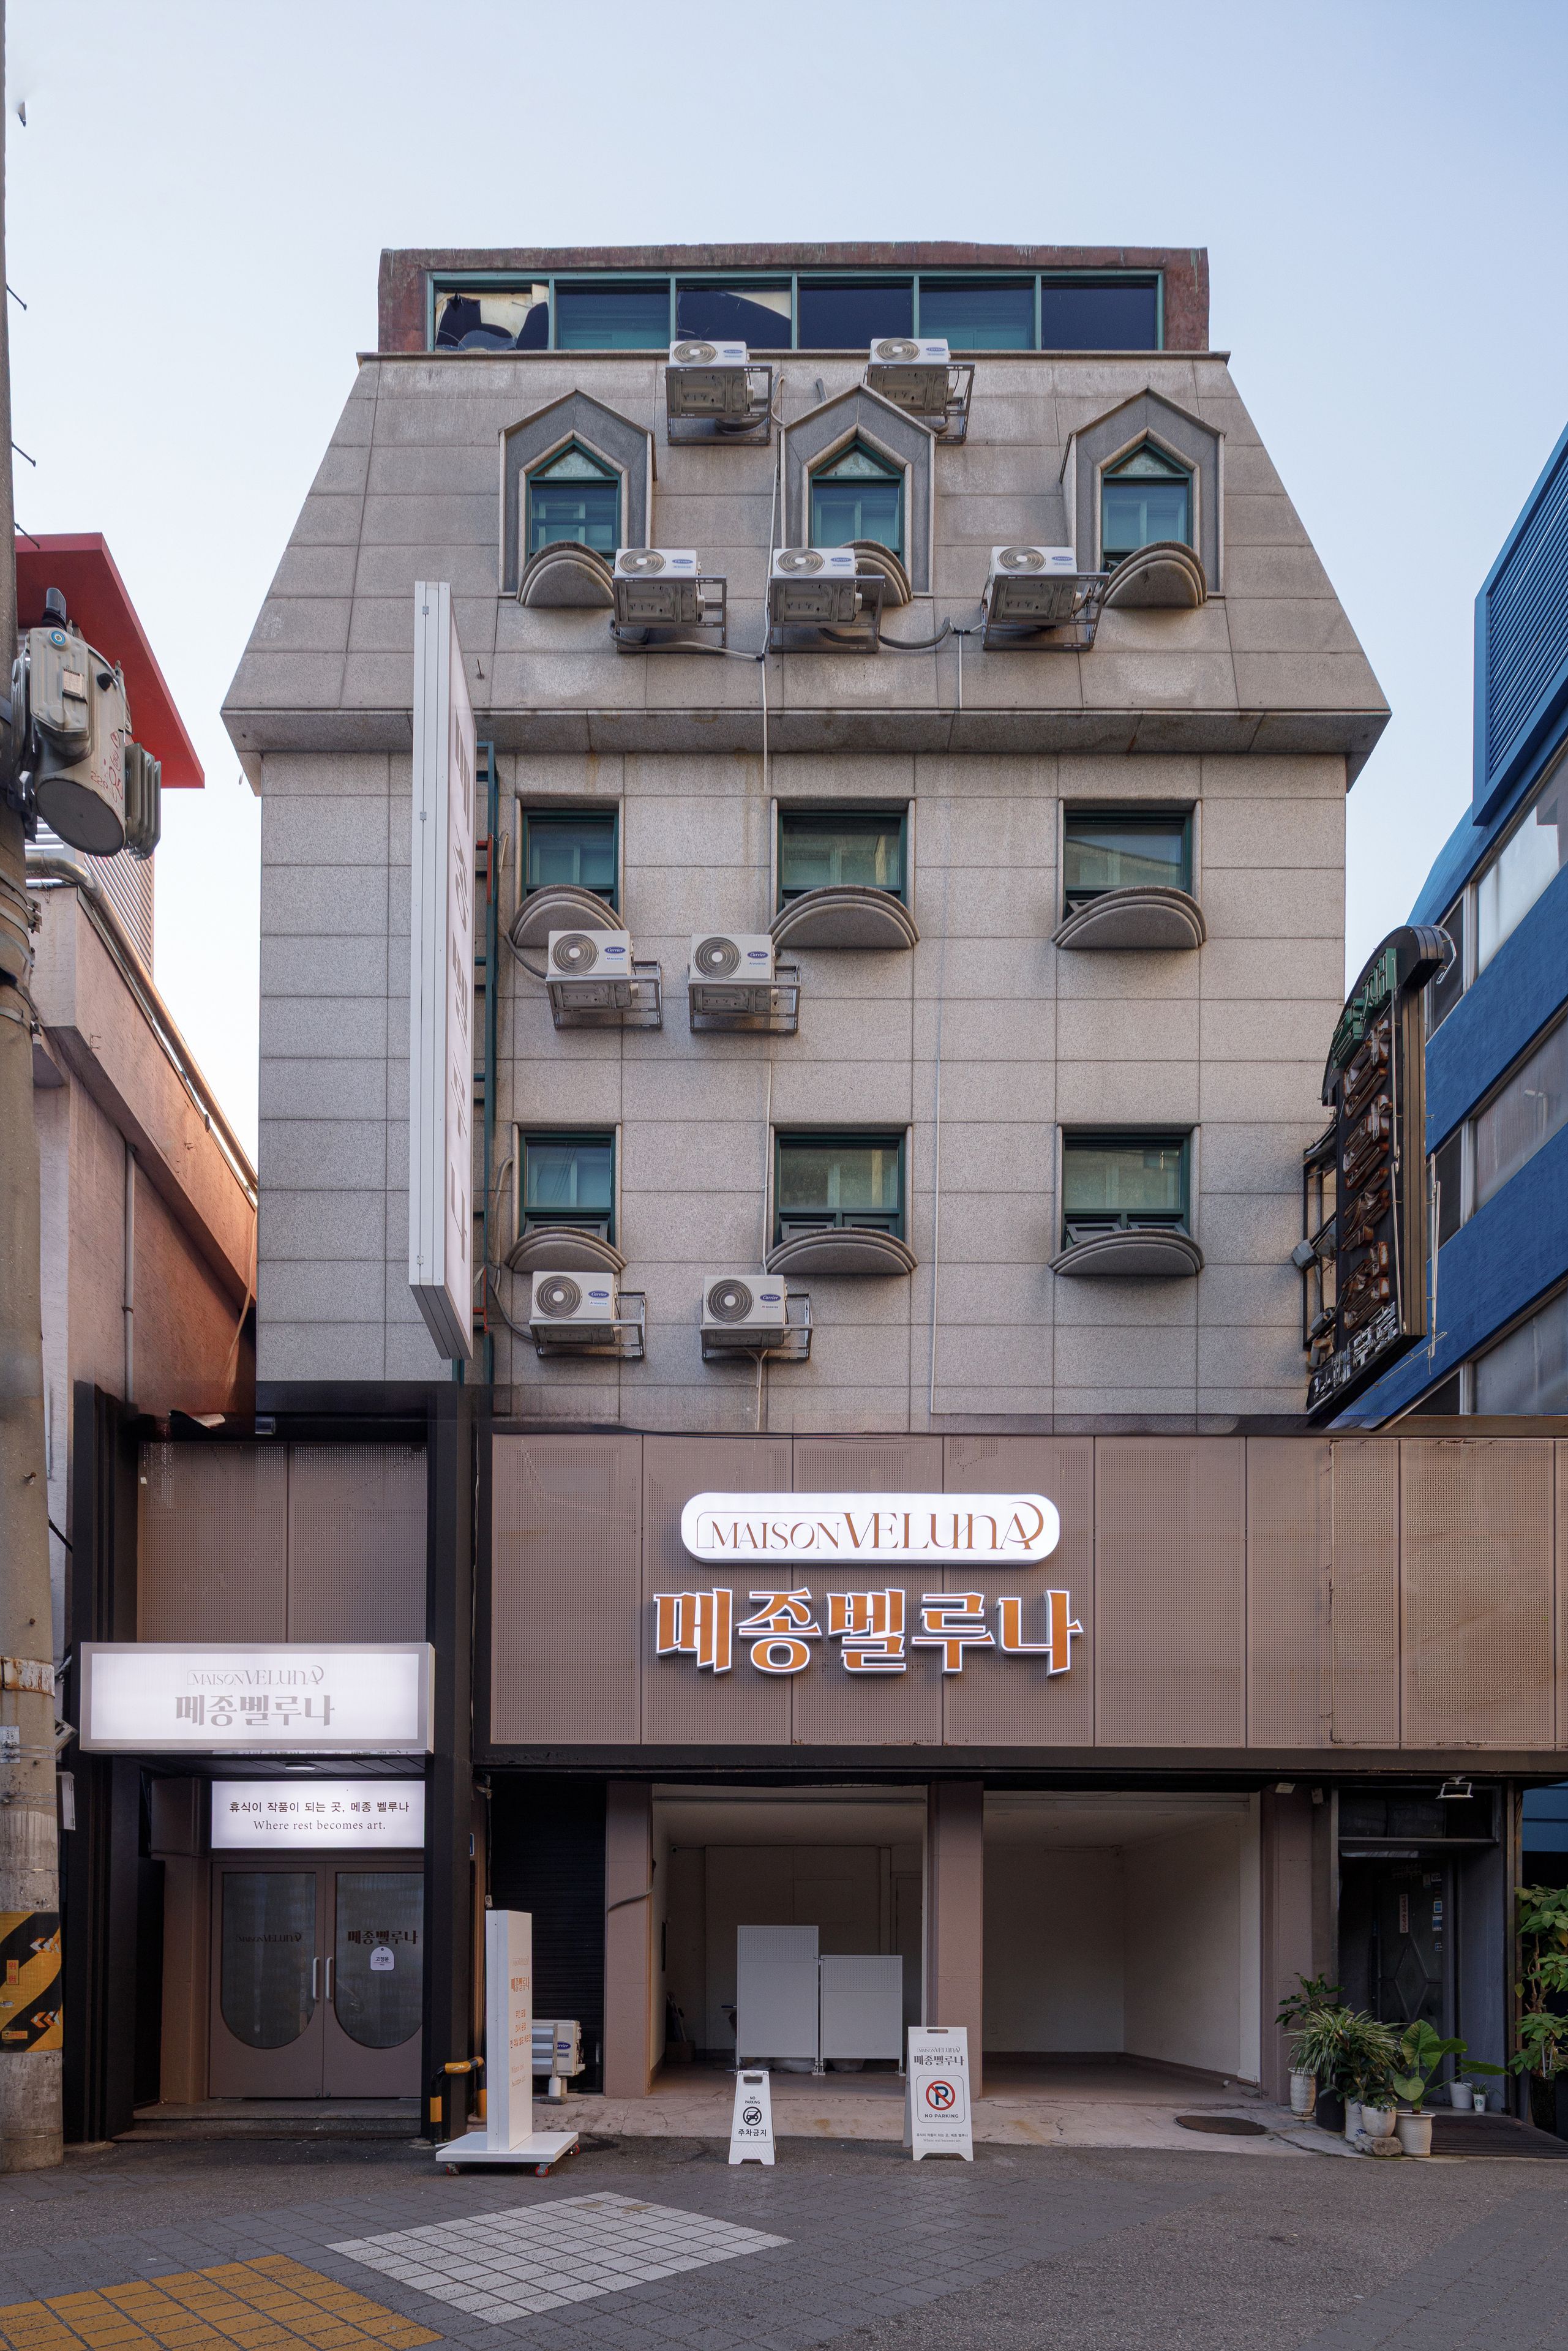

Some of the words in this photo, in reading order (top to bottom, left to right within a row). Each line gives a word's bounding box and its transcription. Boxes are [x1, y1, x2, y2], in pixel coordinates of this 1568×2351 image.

[653, 1587, 1084, 1677] 메종벨루나
[174, 1694, 336, 1727] 메종벨루나
[229, 1801, 263, 1813] 휴식이
[267, 1801, 299, 1813] 작품이
[304, 1801, 326, 1813] 되는
[331, 1801, 345, 1813] 곳,
[350, 1801, 372, 1813] 메종
[377, 1801, 410, 1813] 벨루나
[253, 1820, 290, 1830] Where
[293, 1820, 313, 1830] rest
[317, 1820, 364, 1830] becomes
[367, 1820, 386, 1830] art.
[347, 1929, 419, 1945] 메종벨루나
[913, 2055, 964, 2066] 메종벨루나
[738, 2128, 767, 2137] 주차금지
